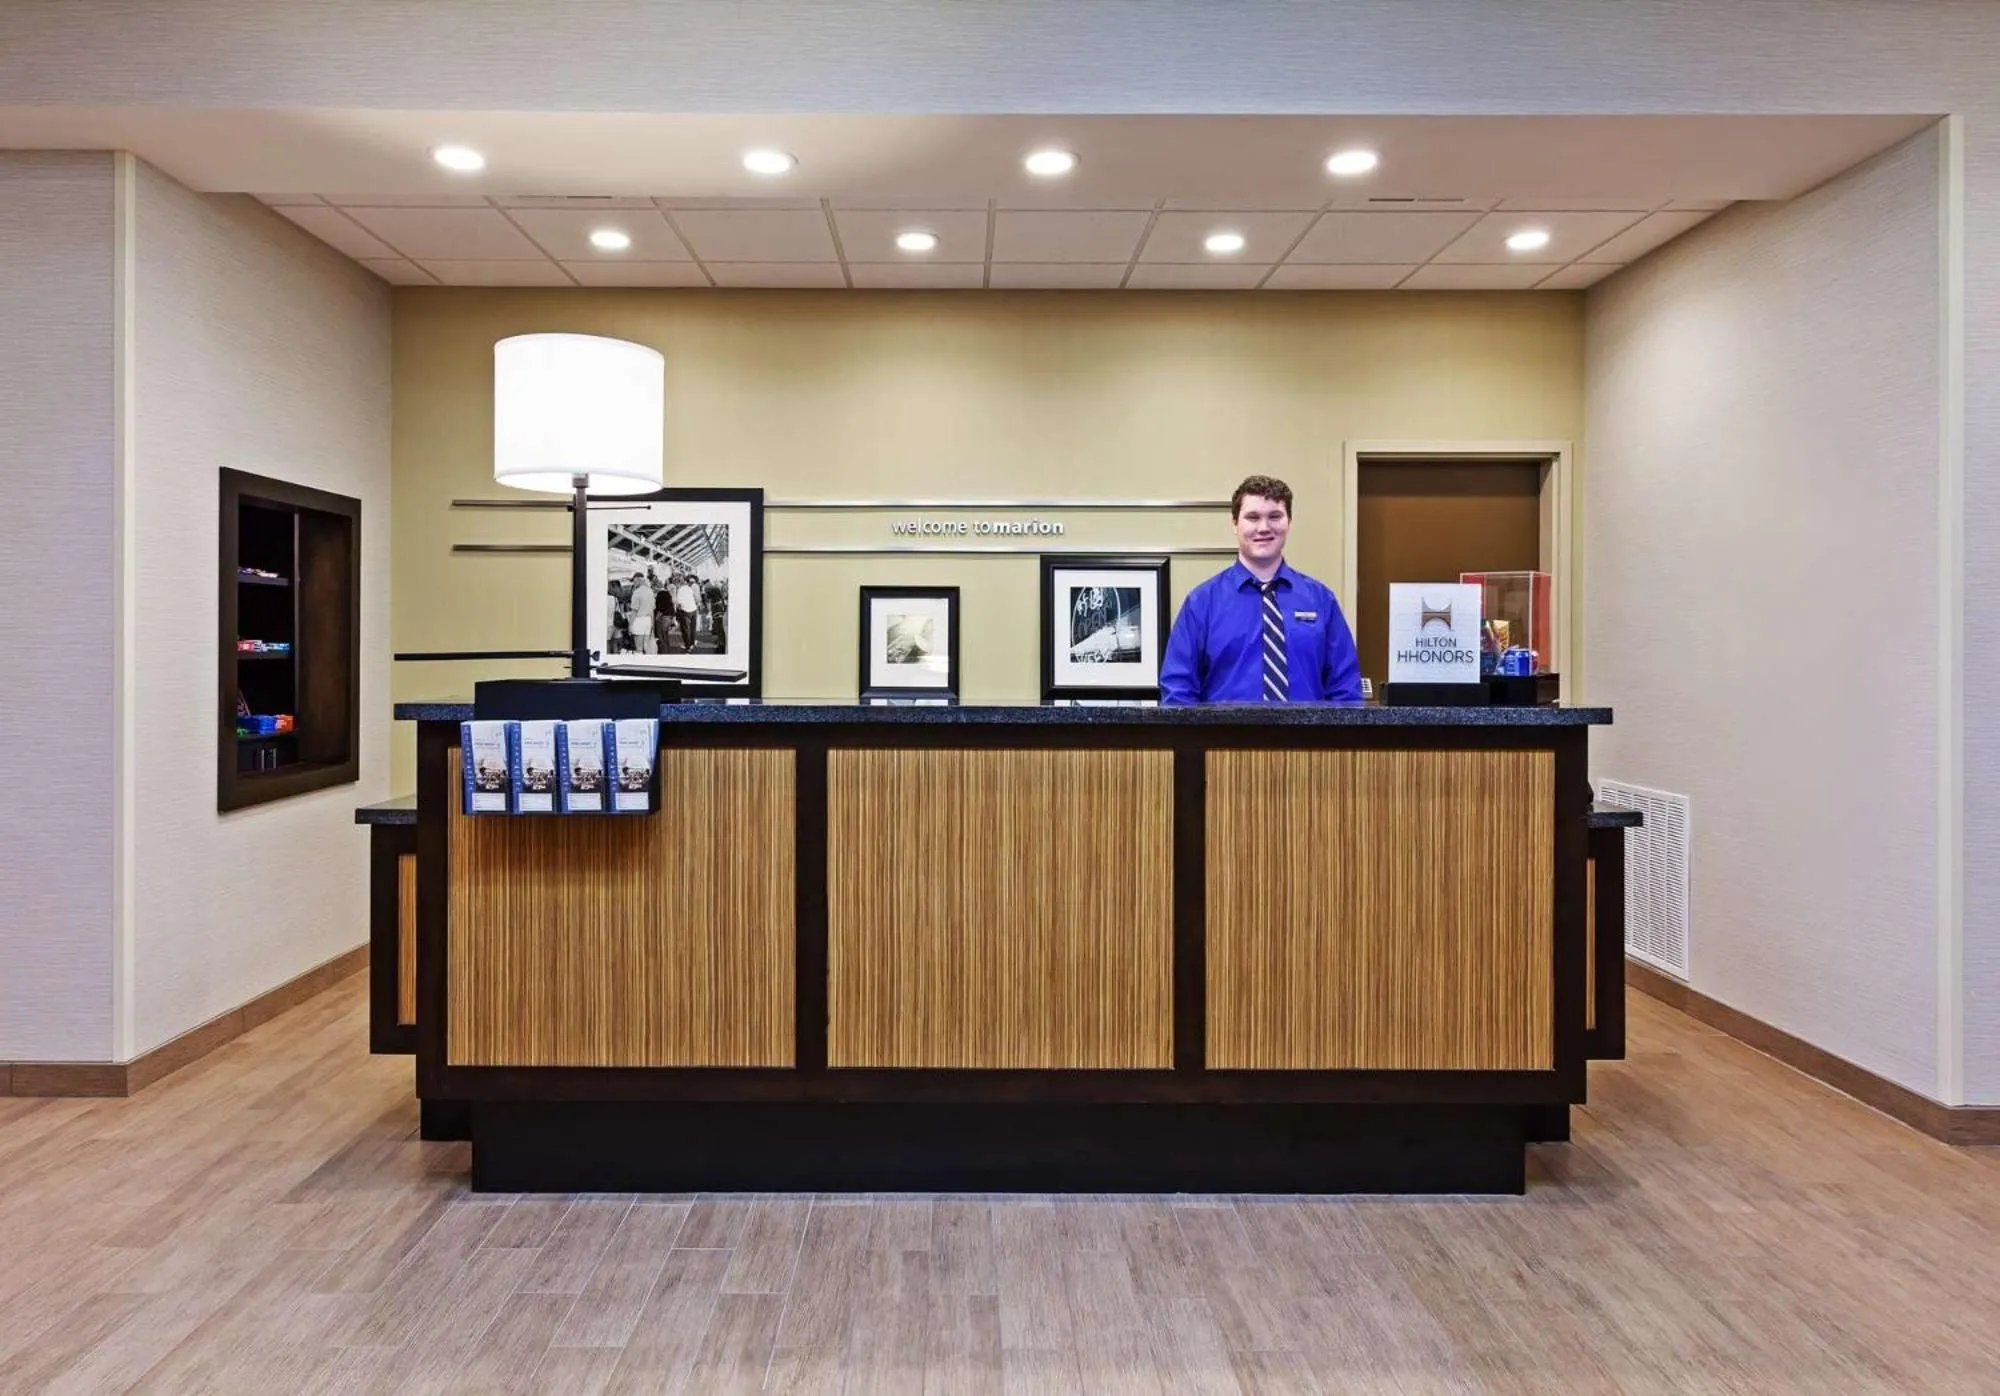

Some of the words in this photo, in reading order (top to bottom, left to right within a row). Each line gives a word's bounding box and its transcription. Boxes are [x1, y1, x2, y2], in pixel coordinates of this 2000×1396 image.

[892, 517, 968, 534] welcome
[993, 519, 1064, 534] marion
[1415, 637, 1457, 648] HILTON
[1397, 650, 1474, 664] HHONORS
